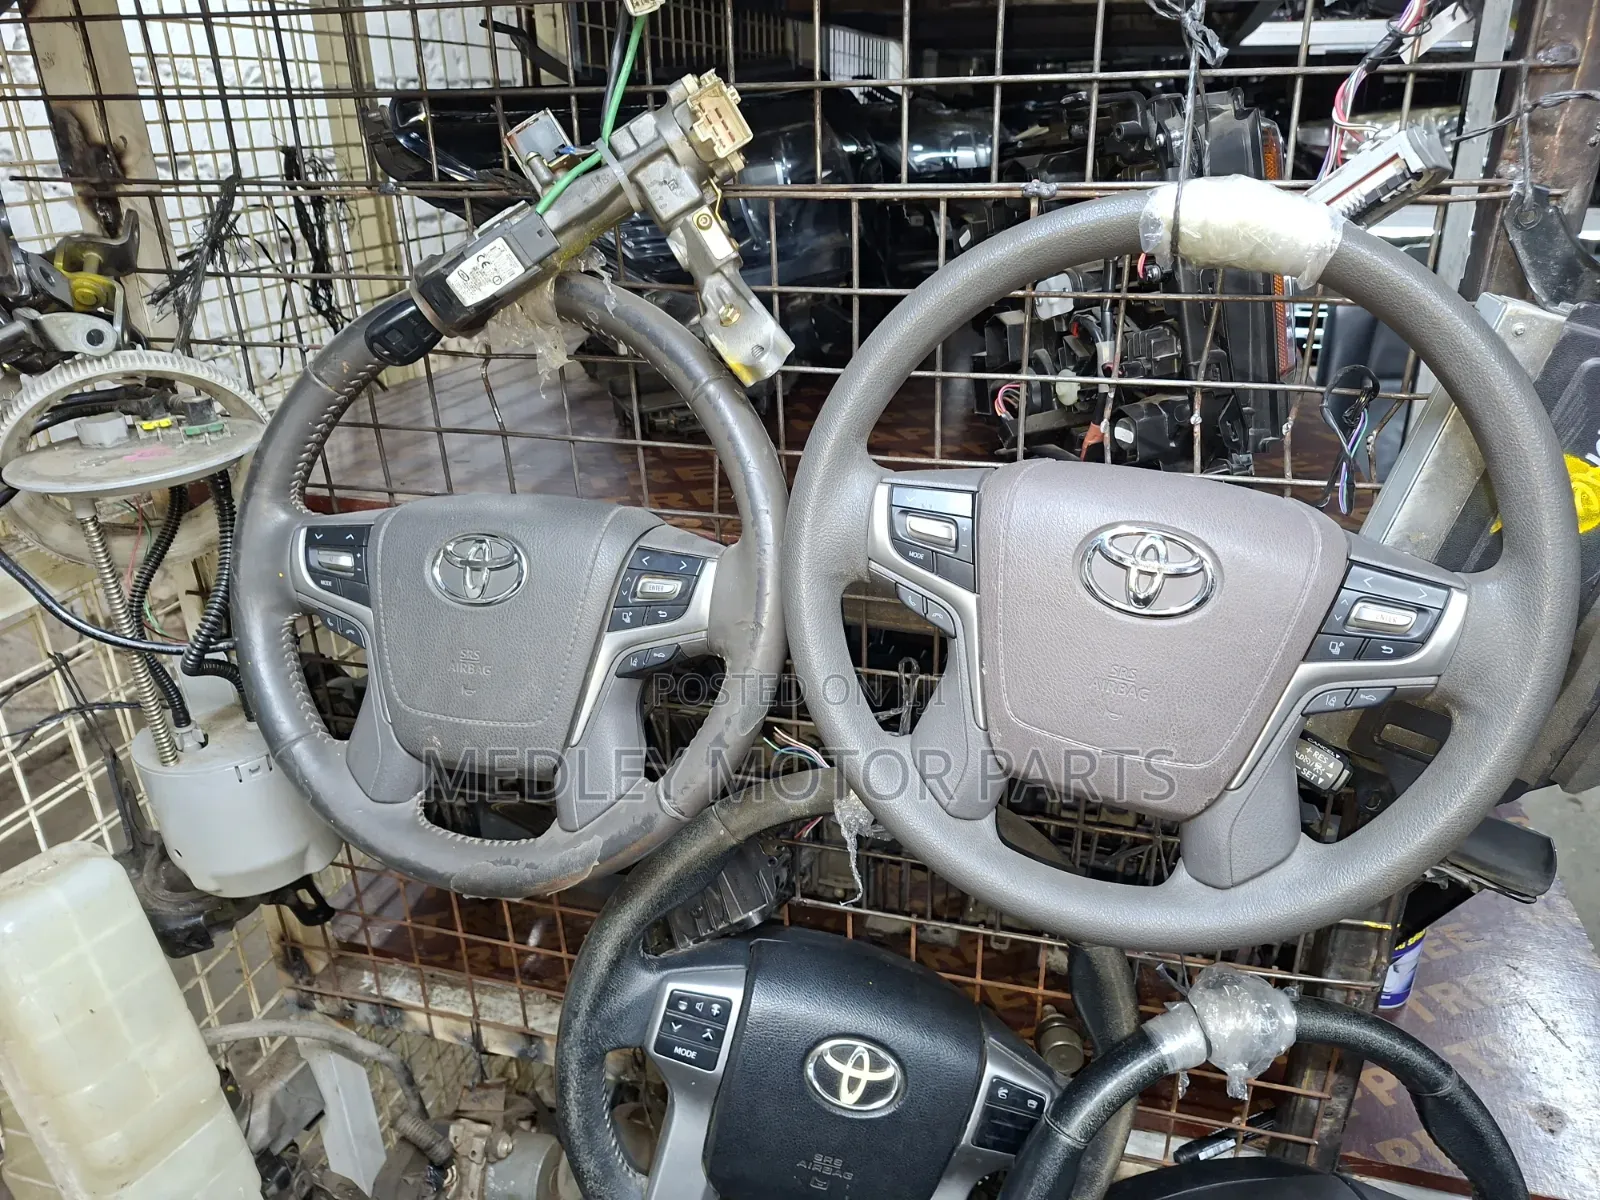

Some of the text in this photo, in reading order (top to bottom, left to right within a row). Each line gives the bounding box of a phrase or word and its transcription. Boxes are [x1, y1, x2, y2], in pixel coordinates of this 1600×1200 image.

[907, 550, 925, 560] MODE
[320, 579, 332, 587] MODE
[648, 584, 664, 592] ENTER
[459, 648, 480, 660] SRS
[447, 662, 492, 676] AIRBAG
[1108, 664, 1138, 681] SRS
[1089, 677, 1150, 701] AIRBAG
[1307, 737, 1336, 757] CANCEL
[674, 1046, 697, 1059] MODE
[813, 1153, 843, 1167] SRS
[796, 1160, 854, 1180] AIRBAG
